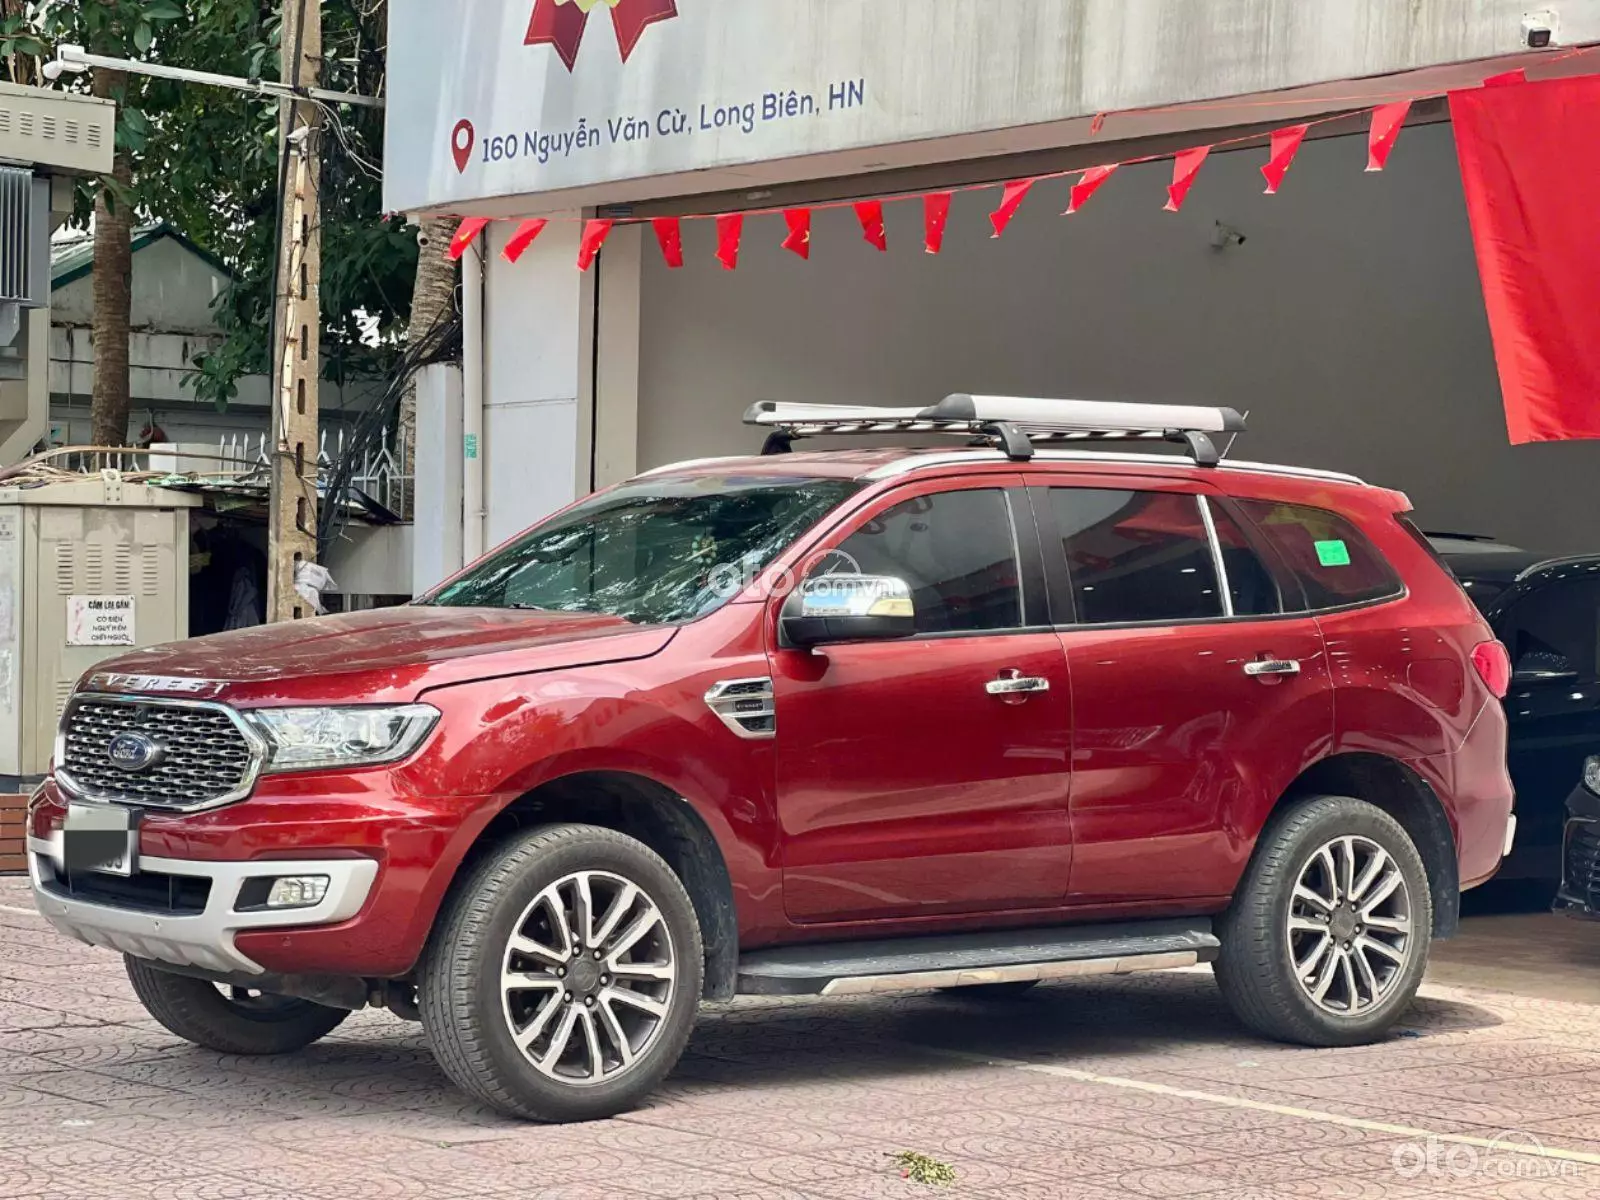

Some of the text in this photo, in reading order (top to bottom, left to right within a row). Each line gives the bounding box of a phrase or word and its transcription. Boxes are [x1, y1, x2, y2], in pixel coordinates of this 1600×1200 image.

[482, 78, 865, 164] 160 Nguyễn Văn Cừ, Long Biên, HN
[87, 673, 231, 695] EVEREST
